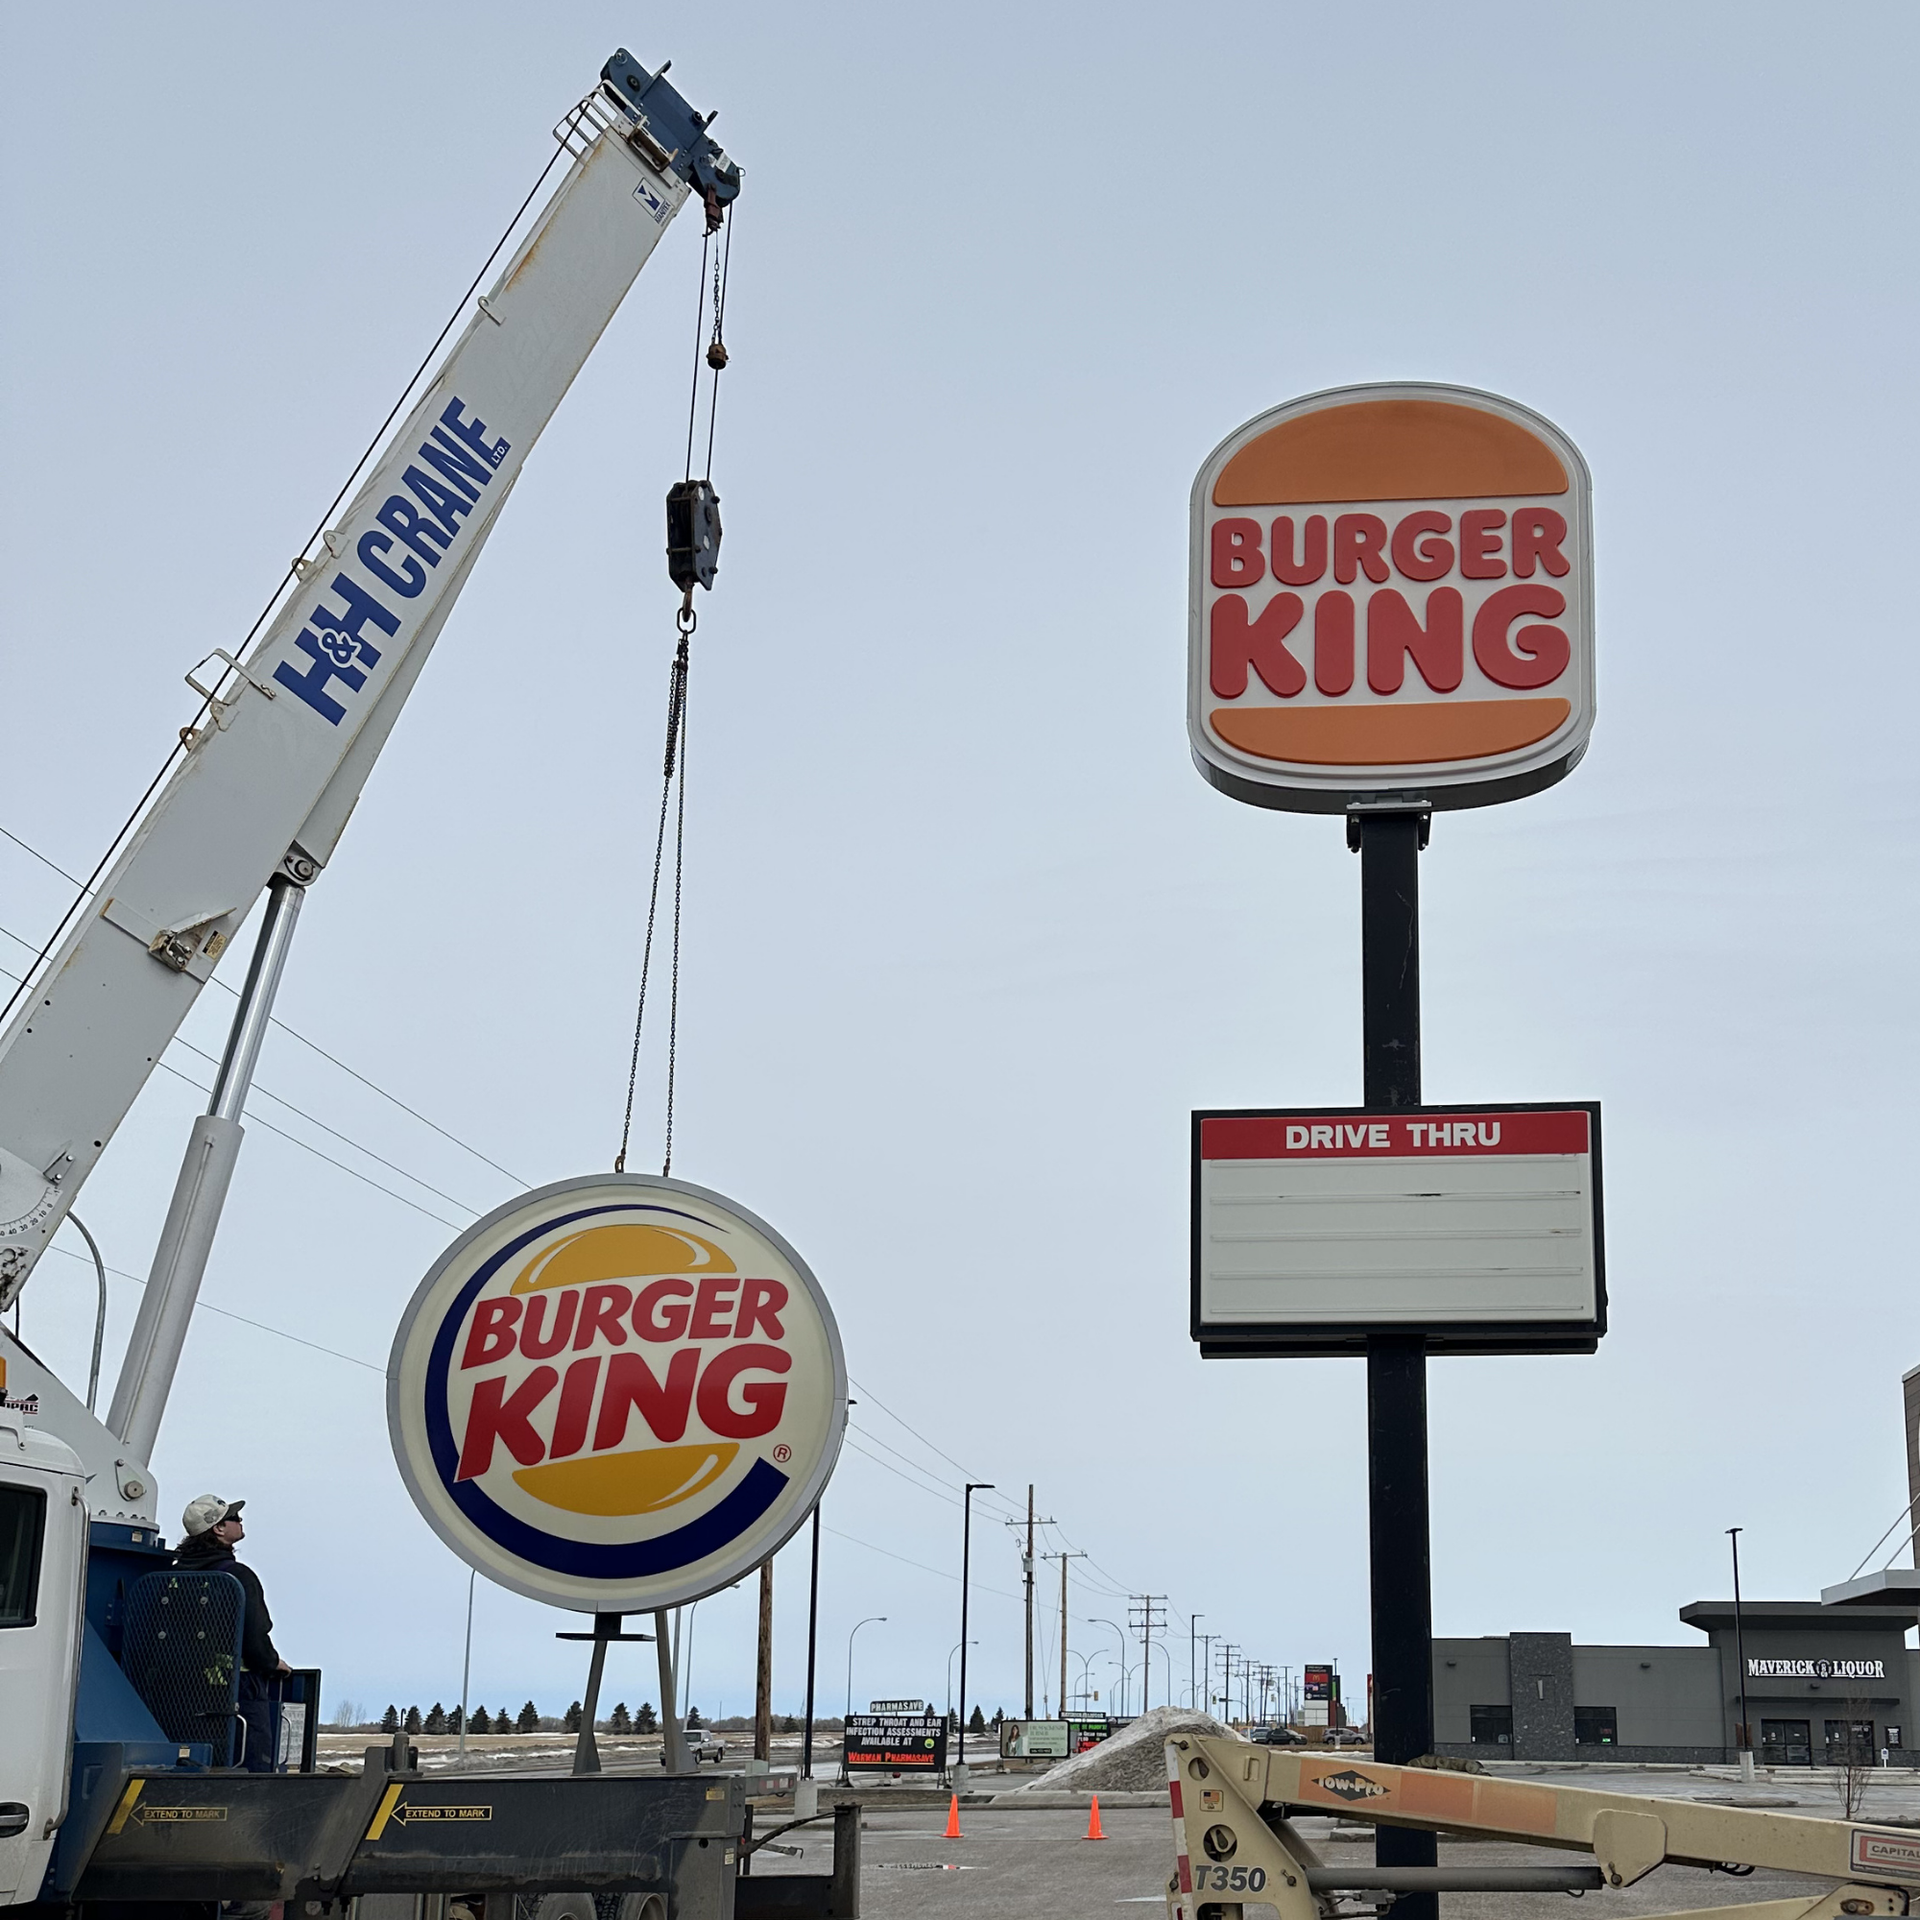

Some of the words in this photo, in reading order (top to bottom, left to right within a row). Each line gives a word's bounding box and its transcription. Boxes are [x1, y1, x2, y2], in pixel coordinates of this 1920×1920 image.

[1211, 507, 1571, 589] BURGER
[272, 572, 402, 726] H&H
[357, 396, 512, 599] CRANE
[1210, 583, 1571, 700] KING
[1286, 1124, 1391, 1149] DRIVE
[1406, 1122, 1501, 1147] THRU
[39, 1210, 47, 1218] 10
[460, 1278, 789, 1370] BURGER
[454, 1343, 792, 1483] KING
[1748, 1659, 1816, 1677] MAVERICK
[1832, 1660, 1885, 1678] LIQUOR
[871, 1702, 923, 1712] PHARMASAVE
[852, 1717, 877, 1726] STREP
[880, 1718, 907, 1727] THROAT
[909, 1718, 924, 1727] AND
[926, 1719, 942, 1727] EAR
[846, 1727, 884, 1736] INFECTION
[886, 1728, 941, 1737] ASSESSMENTS
[861, 1737, 900, 1746] AVAILABLE
[902, 1737, 913, 1746] AT
[144, 1810, 178, 1819] EXTEND
[181, 1810, 193, 1819] TO
[195, 1810, 220, 1819] MARK
[405, 1809, 441, 1818] EXTEND
[444, 1809, 456, 1818] TO
[459, 1809, 485, 1817] MARK
[1195, 1865, 1266, 1893] T350
